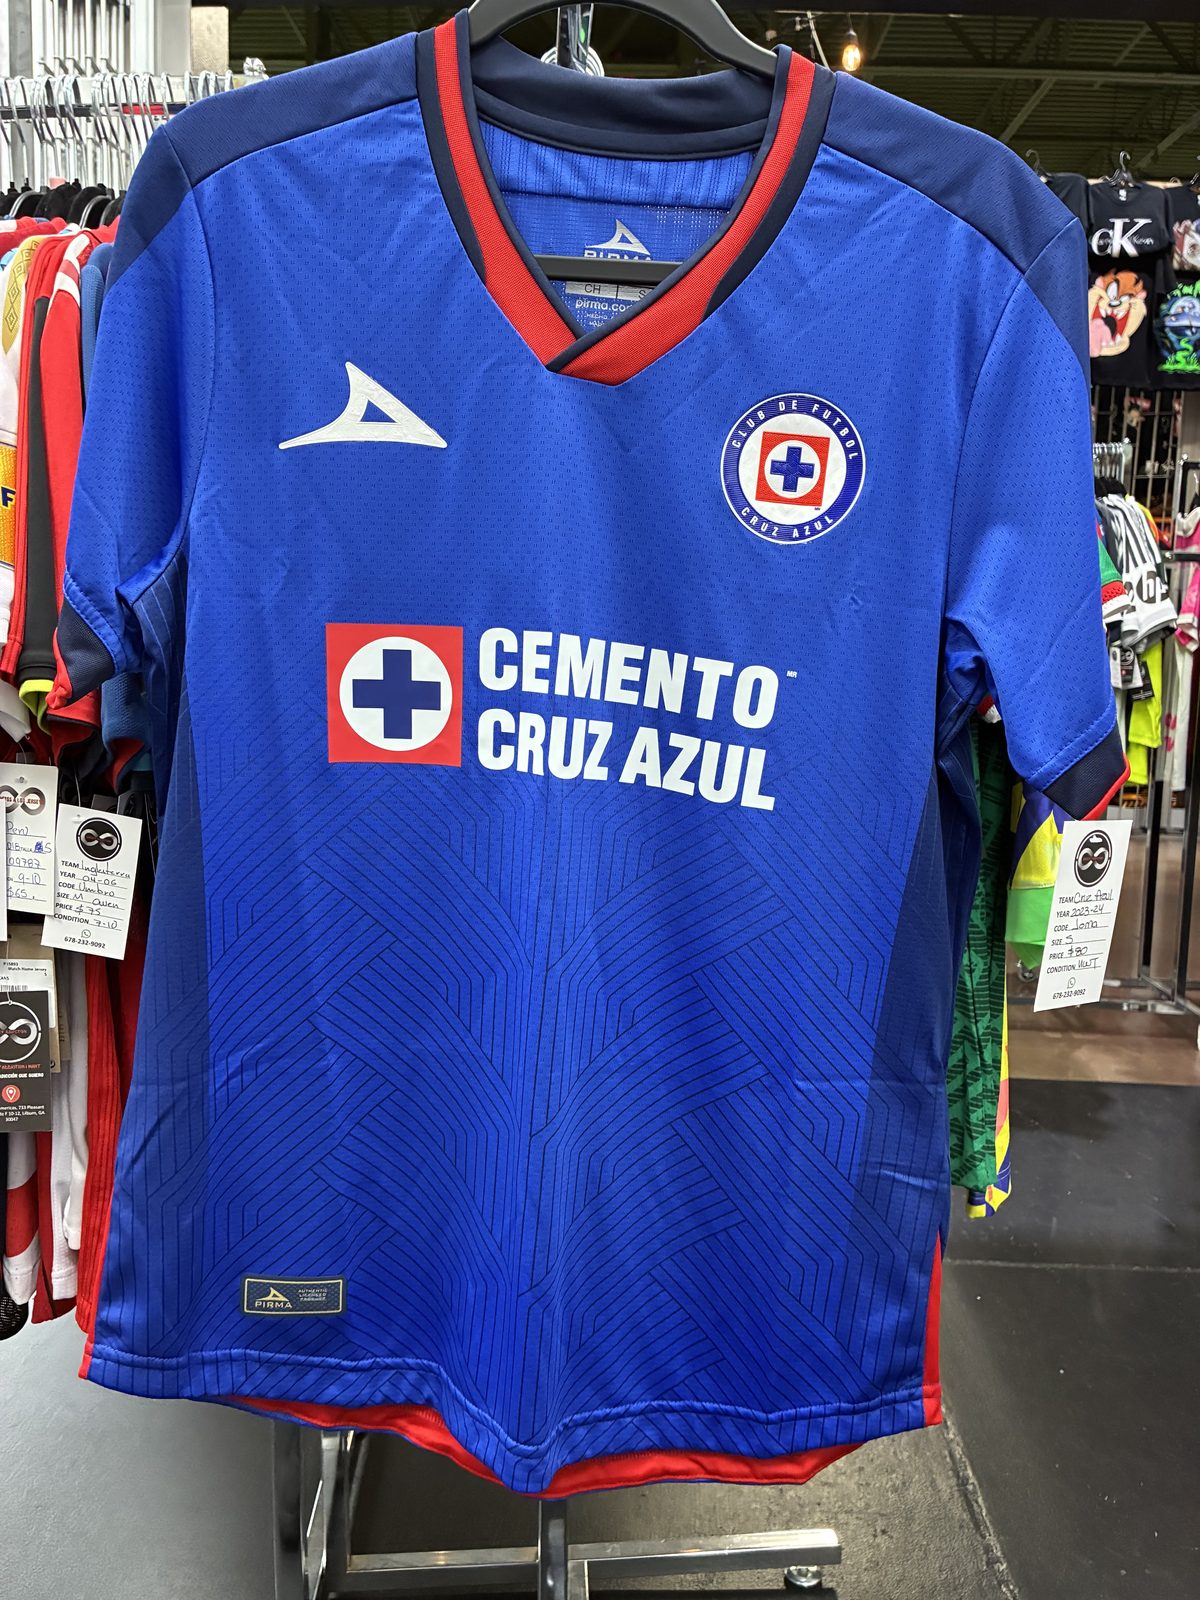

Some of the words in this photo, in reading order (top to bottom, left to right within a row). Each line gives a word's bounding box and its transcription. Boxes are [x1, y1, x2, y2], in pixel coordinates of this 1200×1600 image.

[584, 283, 601, 295] CH
[731, 410, 766, 449] CLUB
[778, 399, 798, 412] DE
[811, 403, 859, 460] FUTBOL
[741, 506, 779, 537] CRUZ
[792, 515, 834, 538] AZUL
[478, 627, 779, 729] CEMENTO
[477, 708, 614, 781] CRUZ
[618, 726, 776, 811] AZUL
[61, 860, 79, 869] TEAM
[59, 871, 76, 879] YEAR
[58, 881, 75, 889] CODE
[79, 882, 115, 897] Umbro
[1058, 896, 1074, 904] TEAM
[55, 902, 73, 911] PRICE
[1056, 910, 1070, 918] YEAR
[1070, 904, 1105, 917] 2023-24
[53, 912, 90, 925] CONDITION
[1054, 924, 1069, 932] CODE
[64, 936, 106, 949] 678-232-9092
[1065, 934, 1074, 945] S
[1049, 951, 1064, 960] PRICE
[1046, 964, 1076, 974] CONDITION
[1053, 988, 1087, 1000] 678-232-9092
[254, 1301, 293, 1309] PIRMA
